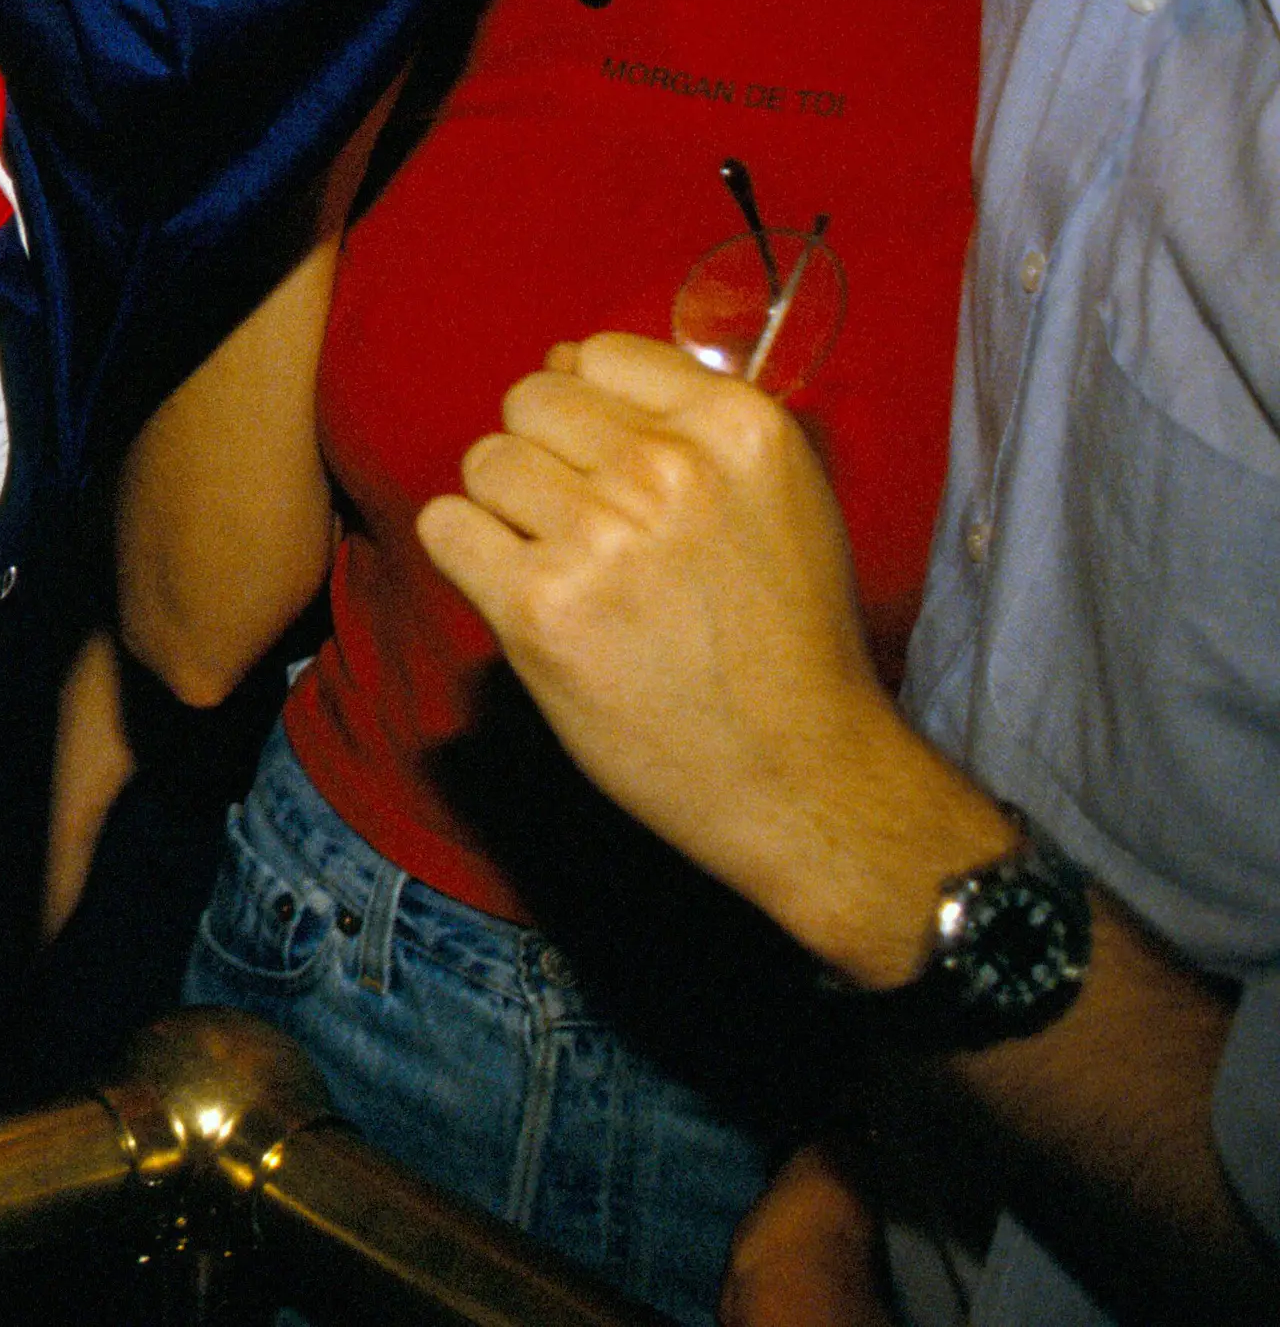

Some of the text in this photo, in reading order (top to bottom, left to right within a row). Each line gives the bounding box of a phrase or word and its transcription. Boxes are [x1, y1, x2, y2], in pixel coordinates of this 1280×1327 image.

[601, 57, 846, 117] MORGAN DE TOI
